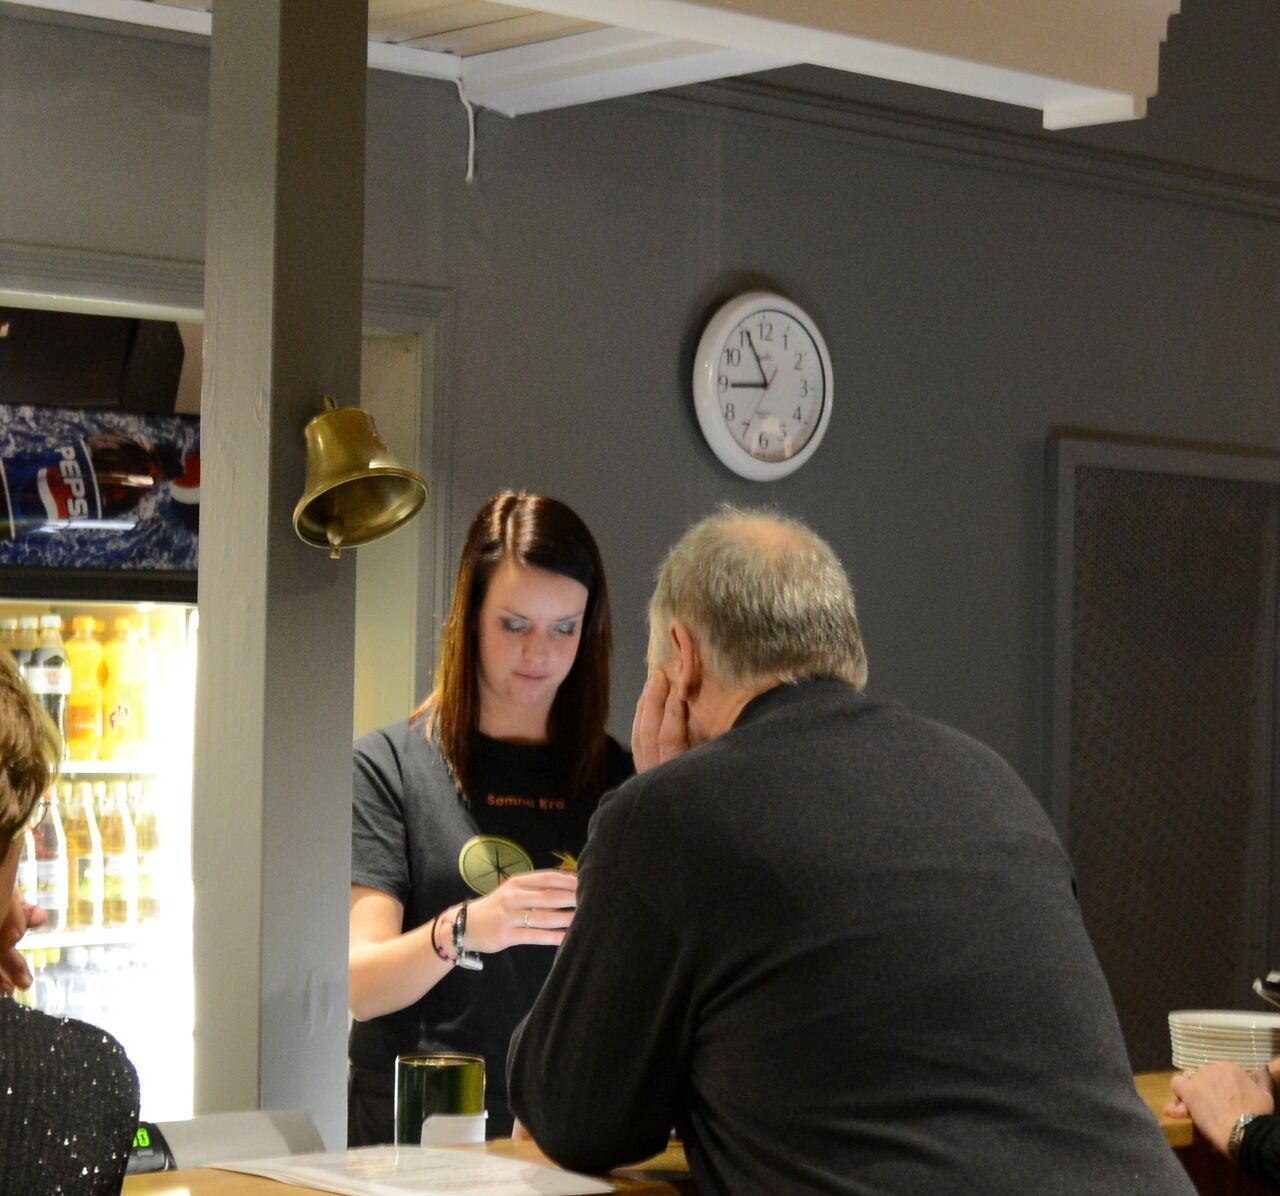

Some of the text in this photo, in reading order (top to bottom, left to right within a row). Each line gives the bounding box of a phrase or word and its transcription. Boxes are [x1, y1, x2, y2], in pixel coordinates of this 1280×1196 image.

[759, 323, 773, 341] 12
[783, 334, 788, 351] 1
[725, 348, 741, 367] 10
[794, 353, 803, 371] 2
[718, 375, 729, 393] 9
[800, 379, 808, 398] 3
[725, 403, 735, 421] 8
[793, 406, 802, 422] 4
[742, 422, 751, 439] 7
[759, 433, 769, 449] 6
